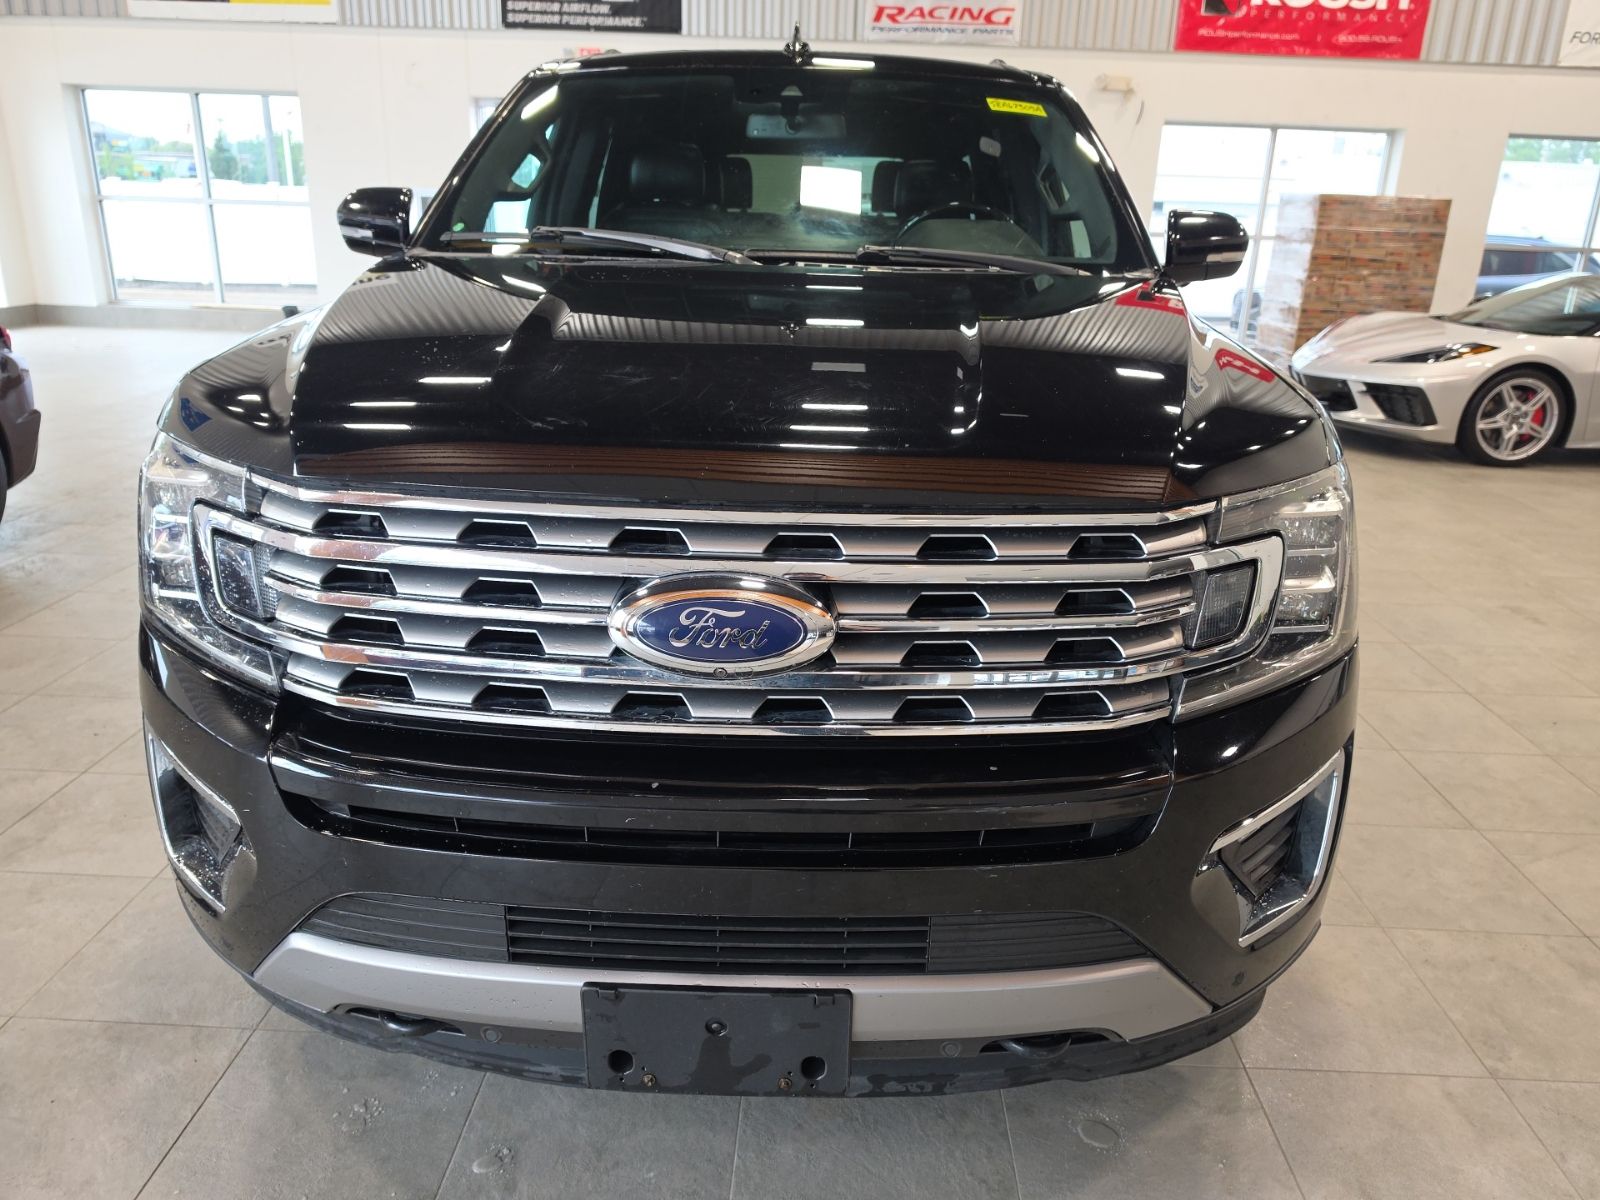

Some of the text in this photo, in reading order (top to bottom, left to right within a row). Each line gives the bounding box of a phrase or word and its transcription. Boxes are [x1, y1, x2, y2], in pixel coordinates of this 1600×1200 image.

[506, 1, 560, 13] SUPERIOR
[873, 5, 1016, 25] RACING
[506, 13, 560, 25] SUPERIOR
[668, 607, 771, 649] Ford
